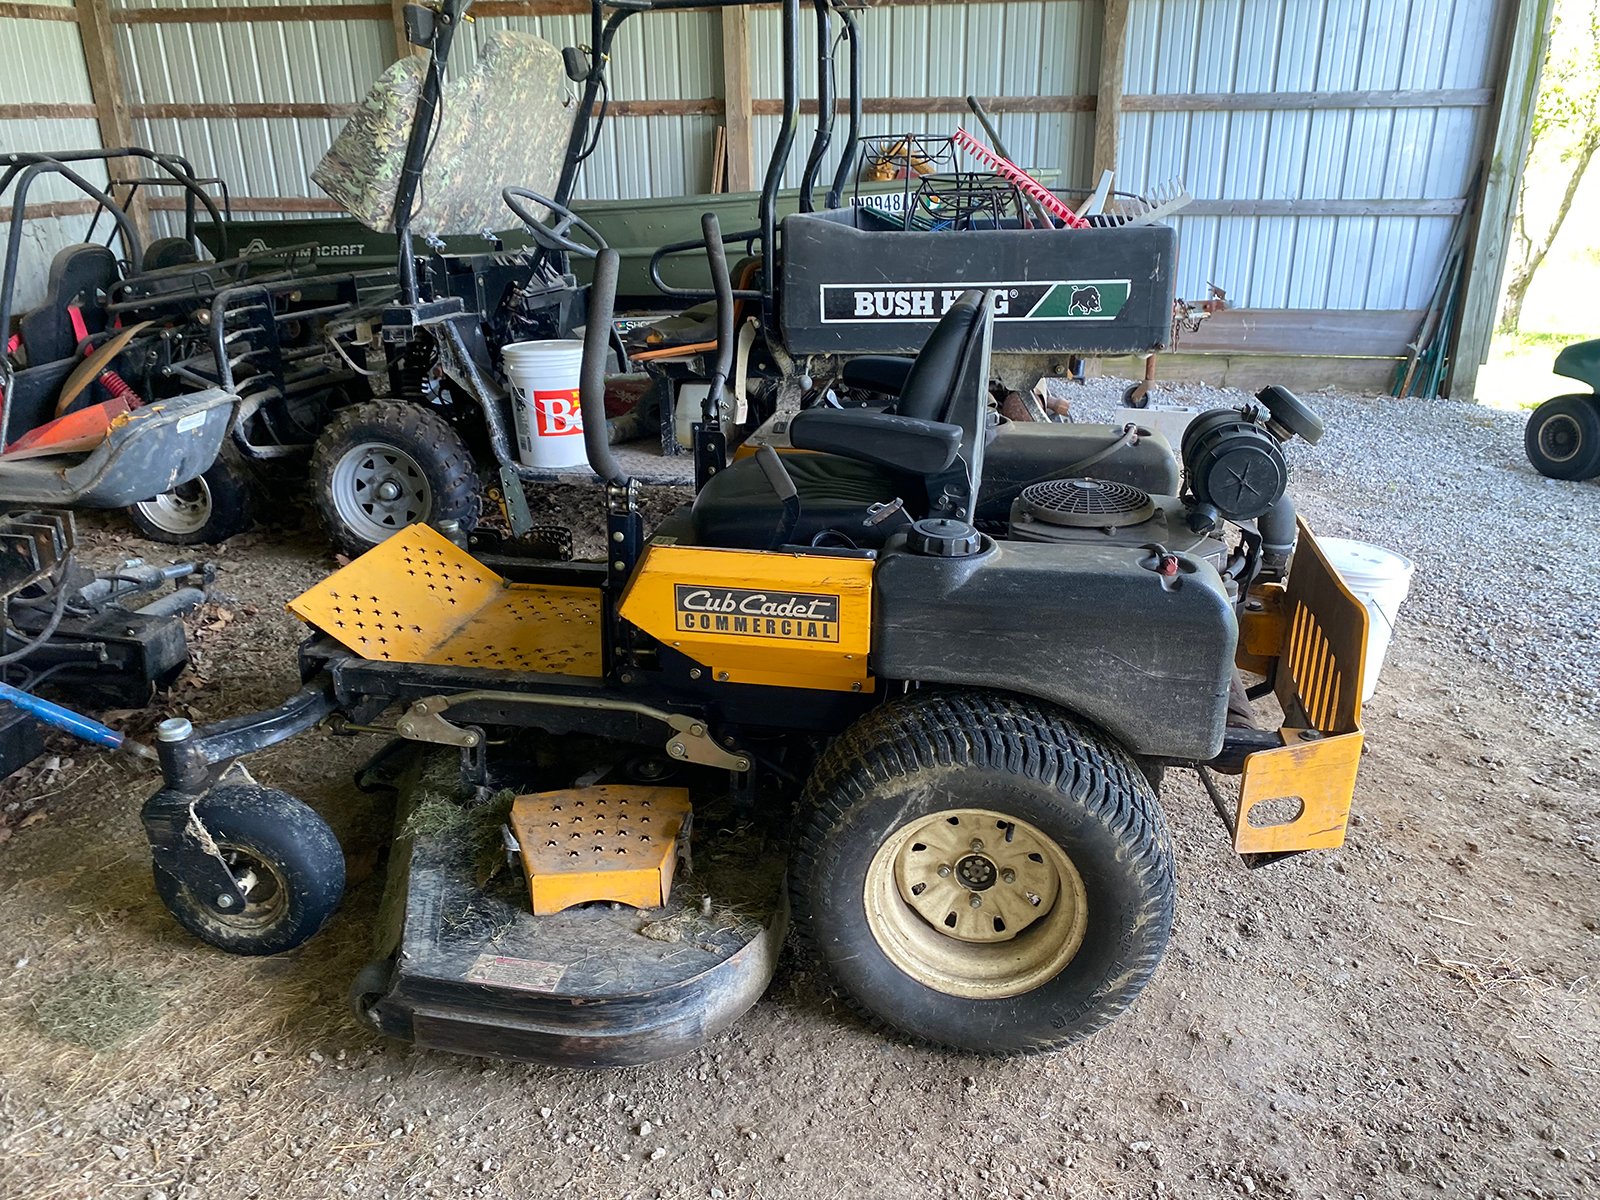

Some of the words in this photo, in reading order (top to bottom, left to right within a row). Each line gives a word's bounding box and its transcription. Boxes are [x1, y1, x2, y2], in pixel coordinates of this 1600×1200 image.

[854, 290, 935, 316] BUSH
[626, 321, 651, 331] SHO
[683, 590, 737, 613] Cub
[684, 613, 831, 638] COMMERCIAL
